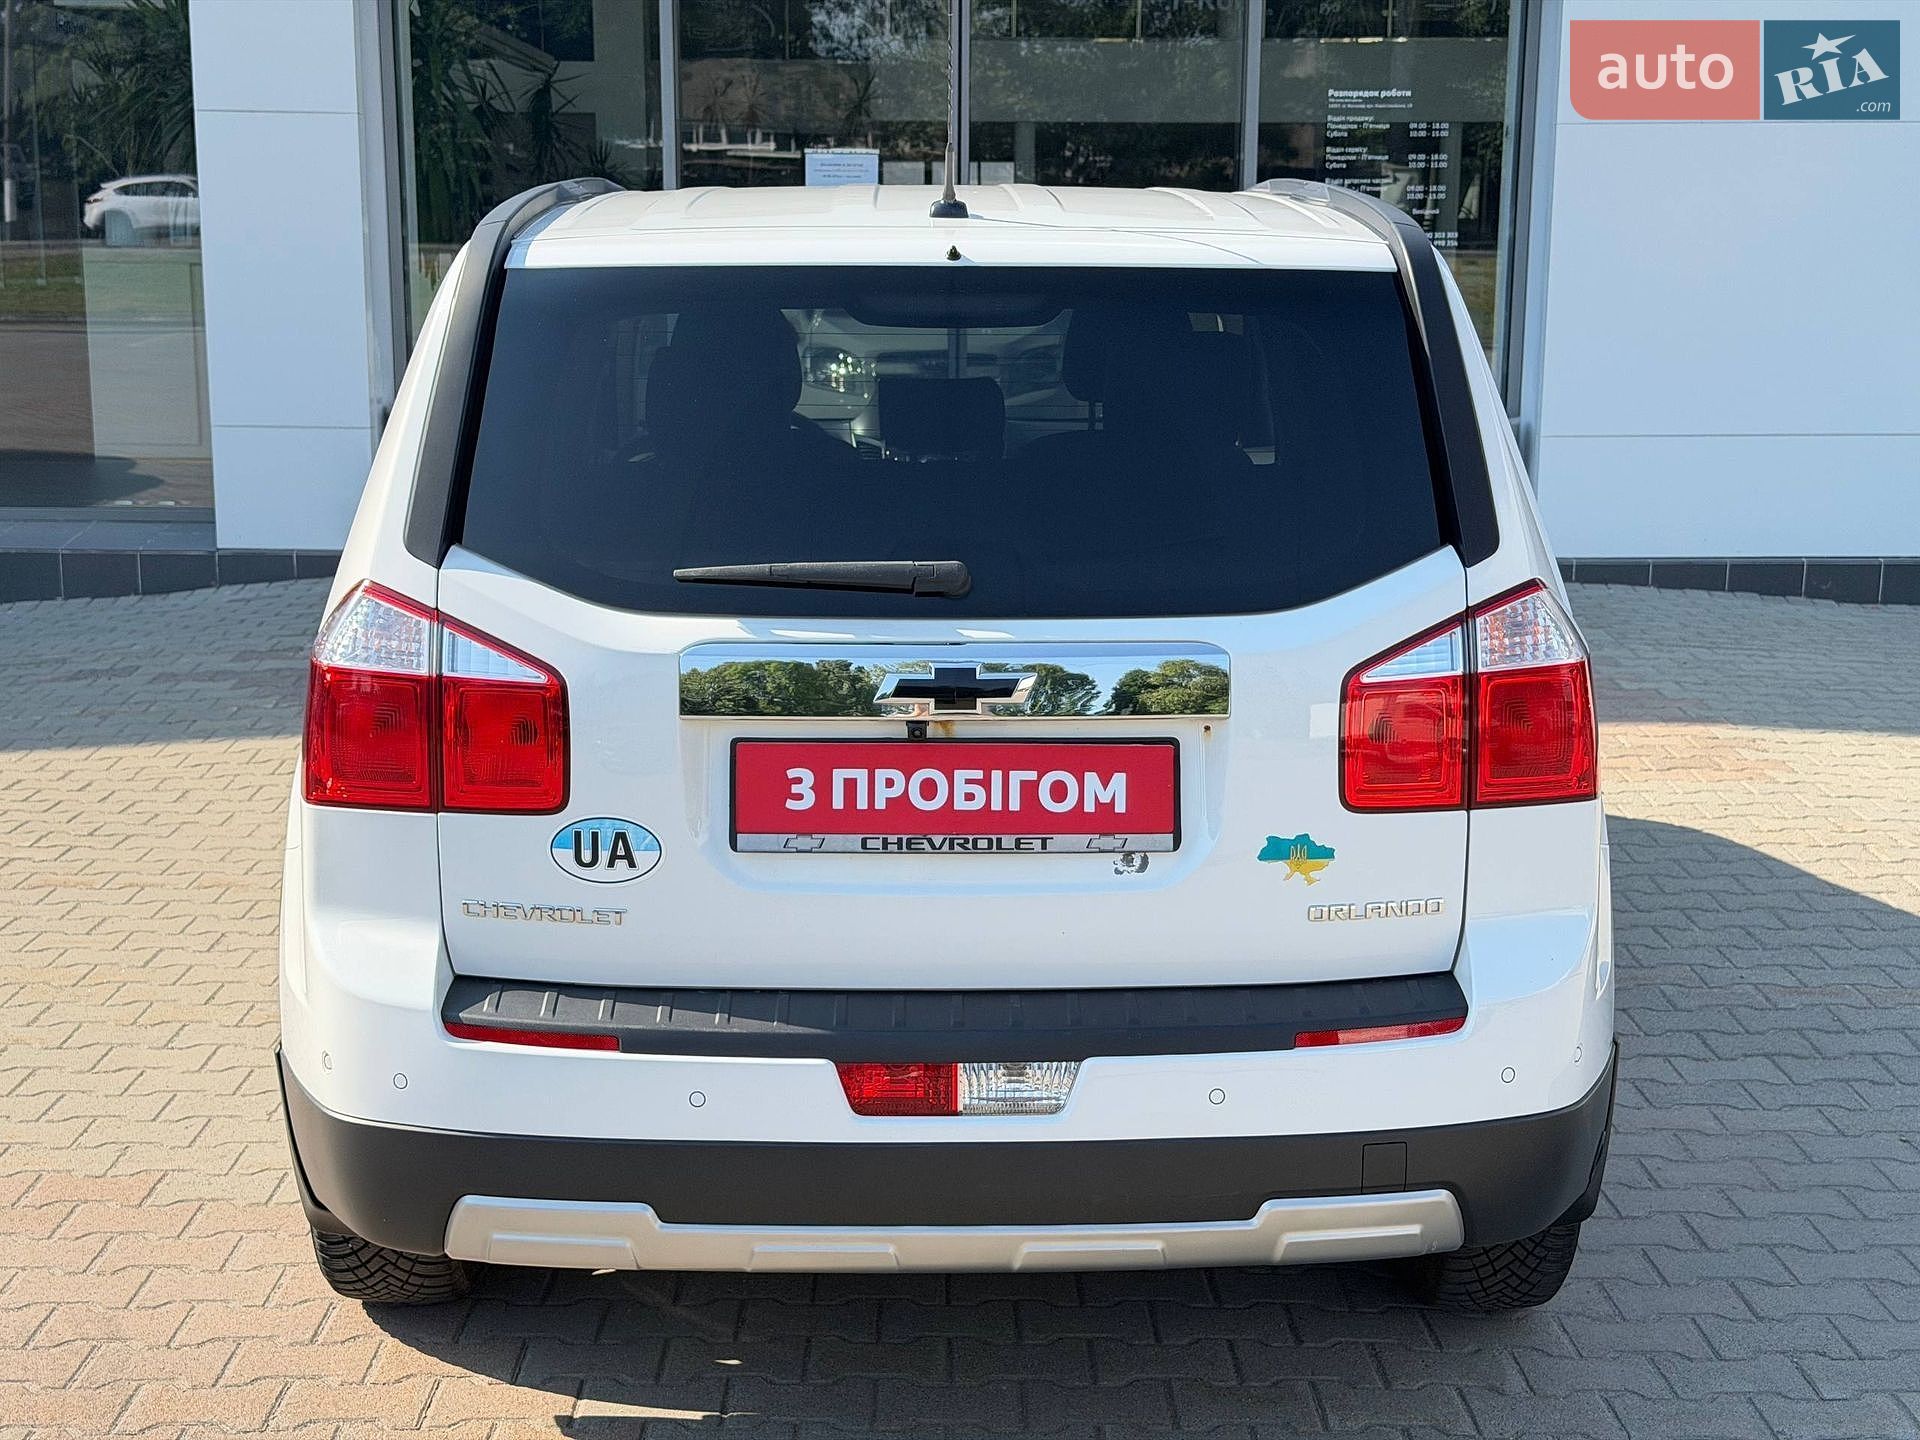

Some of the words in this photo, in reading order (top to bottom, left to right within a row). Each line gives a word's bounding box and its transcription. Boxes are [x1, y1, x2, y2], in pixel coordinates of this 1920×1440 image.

[1328, 88, 1379, 98] Розпорядок
[1380, 88, 1412, 99] роботи
[831, 768, 1127, 814] ПРОБІГОМ
[573, 830, 639, 869] UA
[860, 836, 1054, 852] CHEVROLET
[461, 899, 628, 926] CHEVROLET
[1308, 898, 1445, 922] ORLANDO
